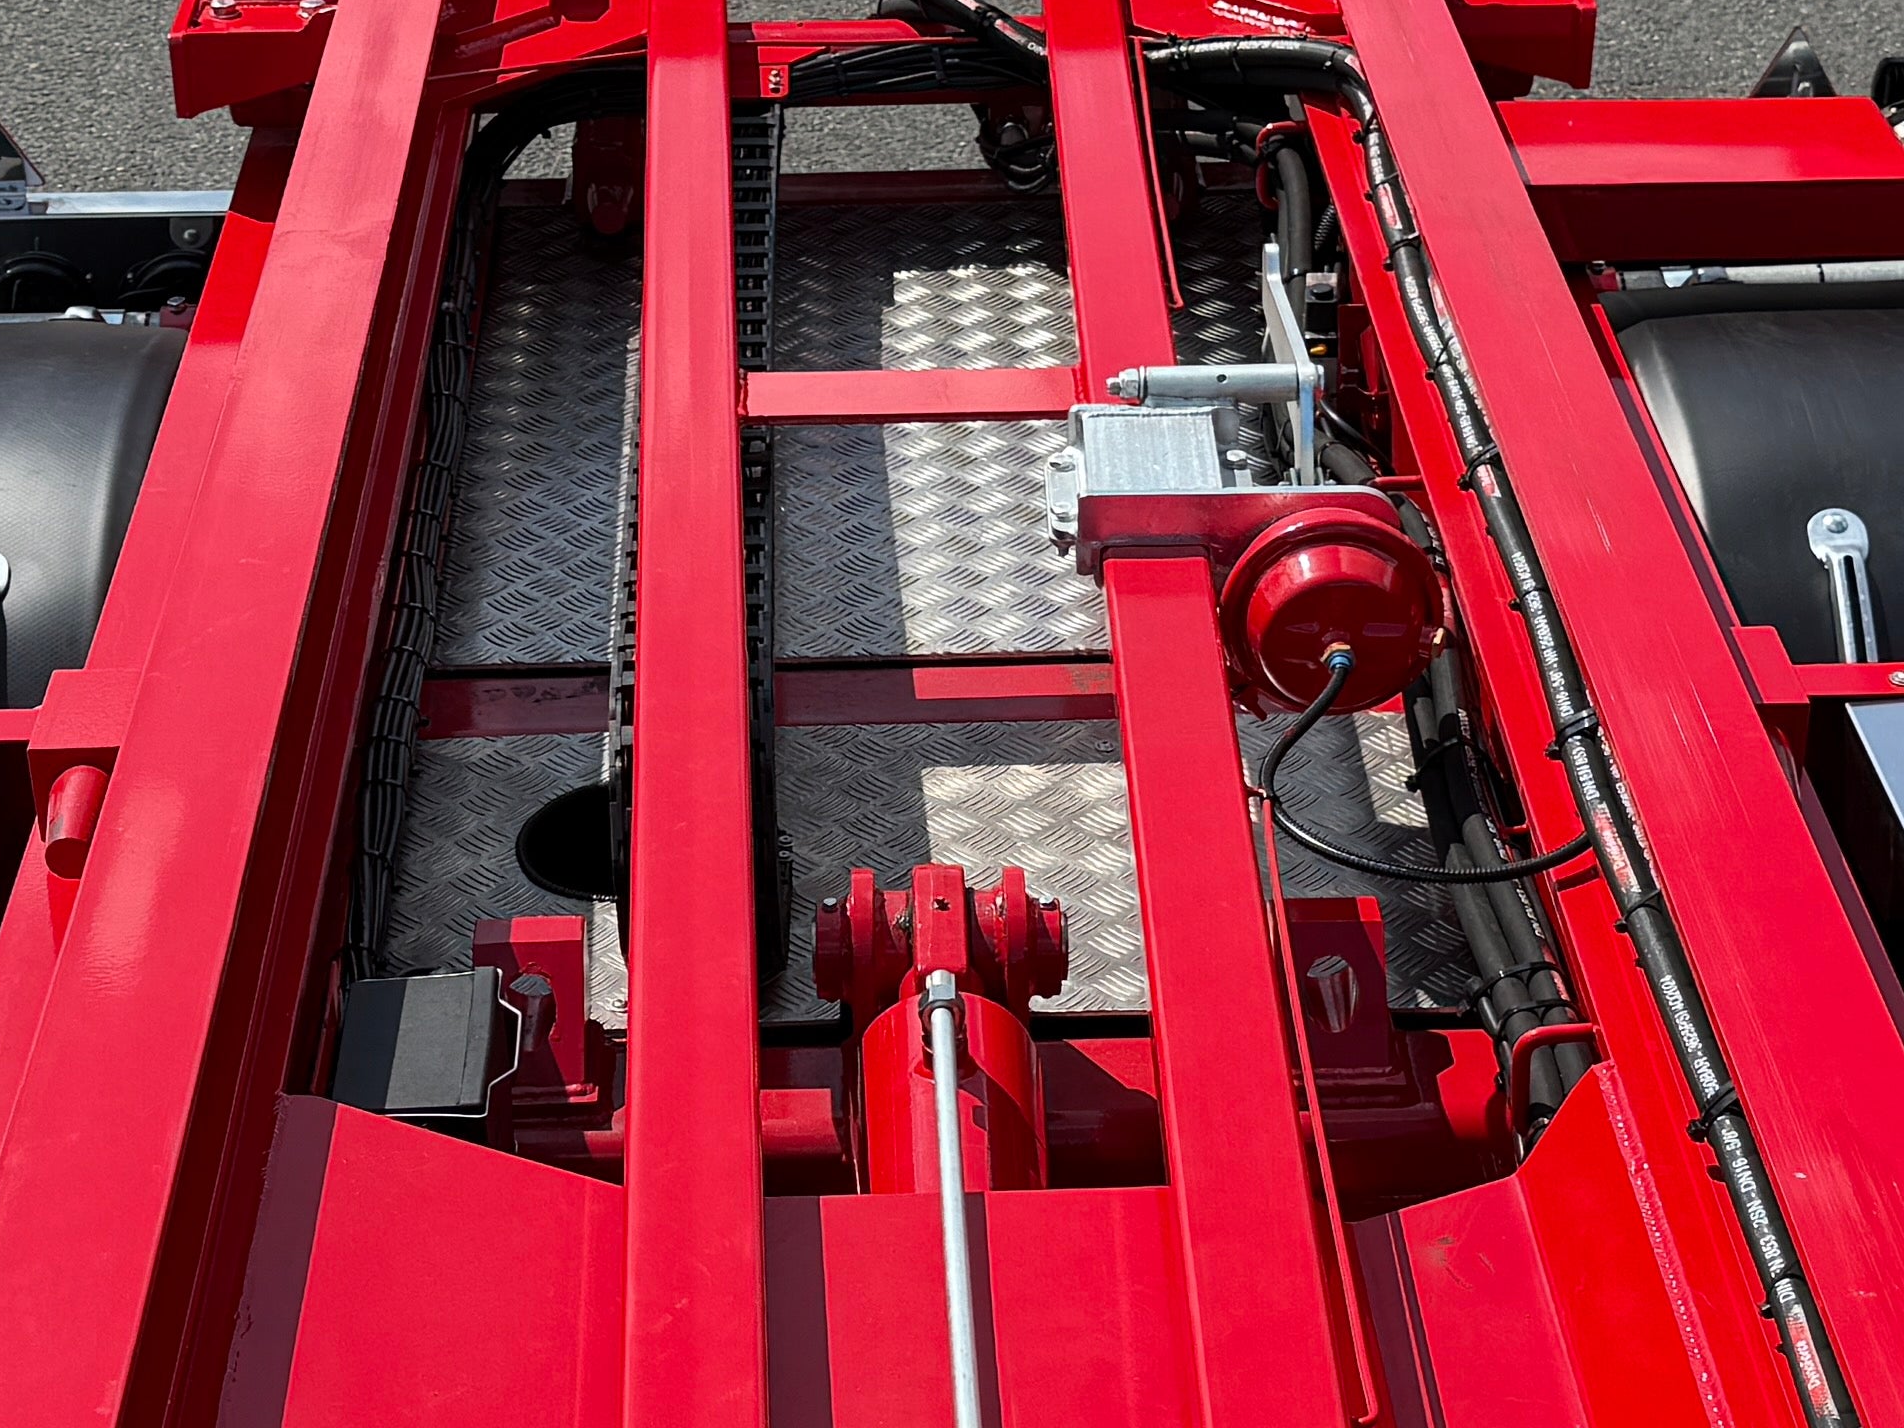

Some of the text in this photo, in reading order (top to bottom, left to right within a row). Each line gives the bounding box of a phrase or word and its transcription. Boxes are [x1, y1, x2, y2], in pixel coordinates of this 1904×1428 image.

[1731, 1157, 1757, 1193] DN16
[1746, 1198, 1768, 1228] 2SN
[1759, 1234, 1781, 1259] 853
[1774, 1277, 1796, 1304] DIN
